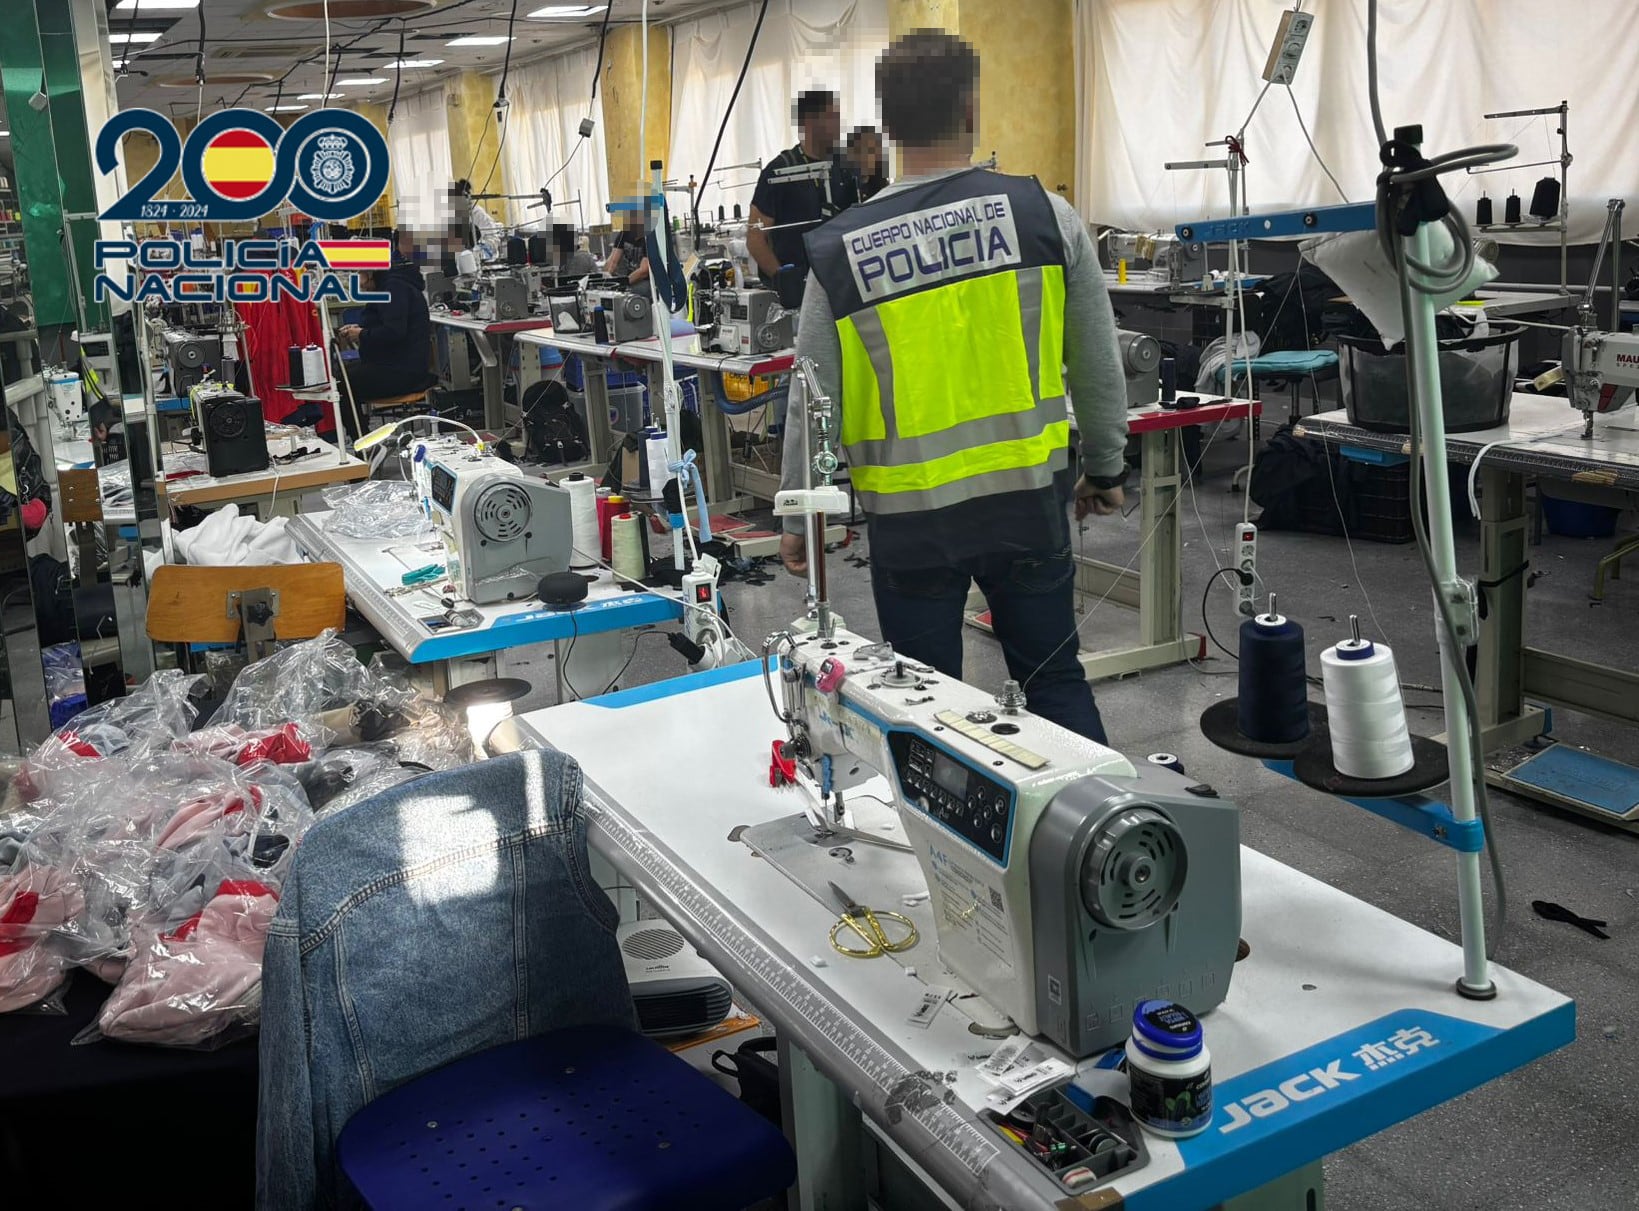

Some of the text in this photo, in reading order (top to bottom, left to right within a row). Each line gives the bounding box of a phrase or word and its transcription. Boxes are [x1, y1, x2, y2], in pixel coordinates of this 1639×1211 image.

[852, 202, 1006, 255] CUERPO NACIONAL DE
[857, 225, 1012, 293] POLICIA
[1352, 1026, 1441, 1071] 杰克
[1218, 1058, 1361, 1134] JACK
